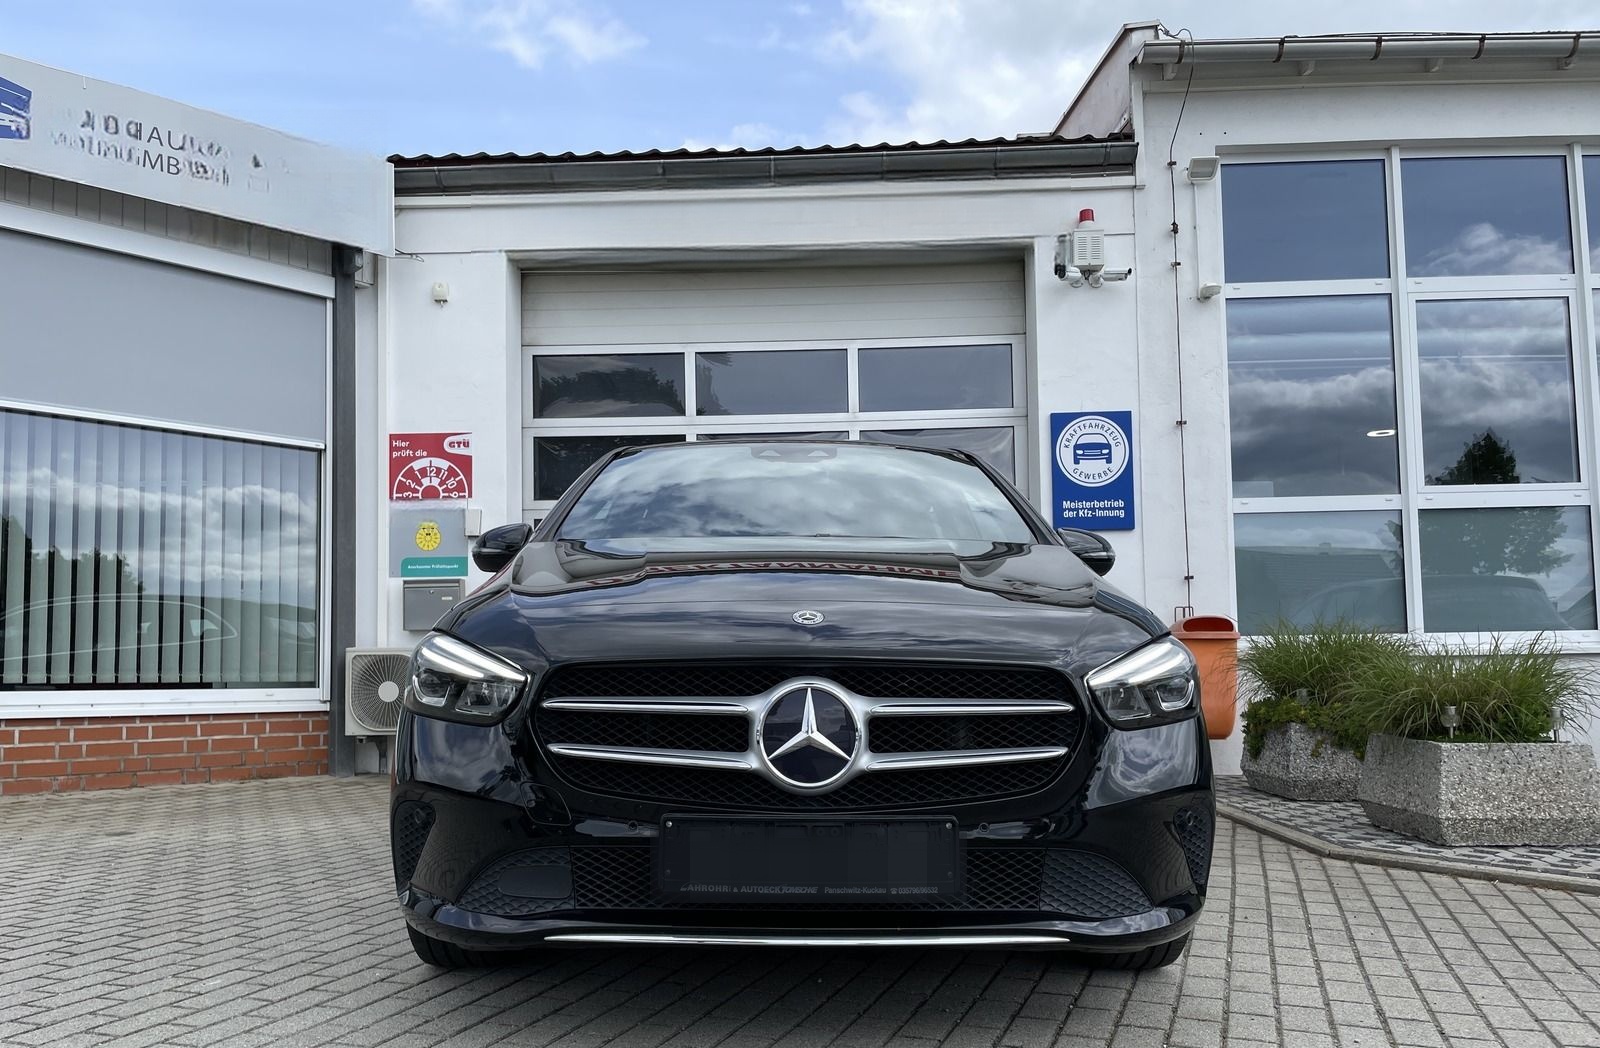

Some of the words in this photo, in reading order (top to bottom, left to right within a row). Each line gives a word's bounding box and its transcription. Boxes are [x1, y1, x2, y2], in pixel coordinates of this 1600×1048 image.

[1063, 422, 1121, 448] KRAFTFAHRZEUG
[448, 439, 470, 448] GTÜ
[392, 450, 413, 458] prüft
[426, 467, 436, 476] 12
[439, 469, 448, 480] 11
[1072, 466, 1114, 480] GEWERBE
[1062, 499, 1125, 508] Meisterbetrieb
[1063, 510, 1077, 518] der
[1078, 509, 1125, 518] Kfz-Innung
[824, 886, 887, 894] Panschwitz-Kuckau
